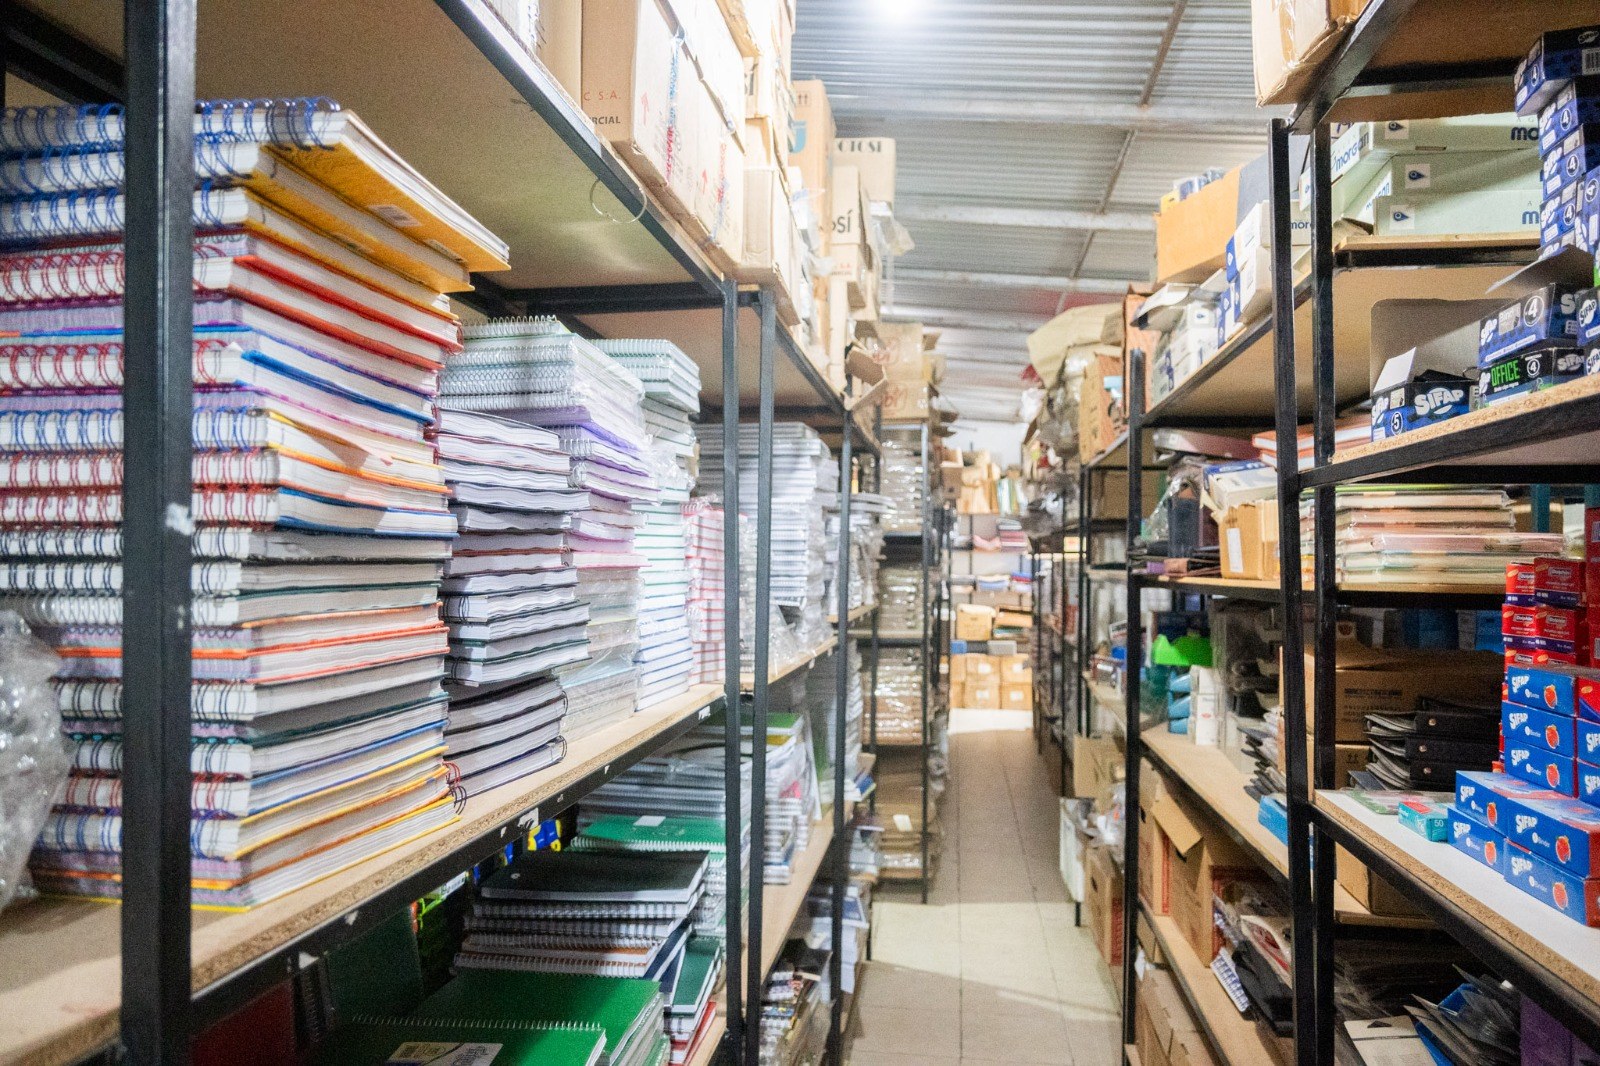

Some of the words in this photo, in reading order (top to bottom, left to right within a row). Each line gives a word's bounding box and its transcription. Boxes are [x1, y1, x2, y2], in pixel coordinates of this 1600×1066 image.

[590, 116, 621, 125] RCIAL
[1511, 126, 1540, 141] mo
[1335, 131, 1370, 172] morgan
[1290, 220, 1312, 230] mor
[1587, 352, 1600, 374] SIFA
[1490, 360, 1520, 387] OFFICE
[1414, 388, 1464, 416] SIFAP
[1511, 675, 1530, 694] SIFAP
[1508, 712, 1529, 730] SIFAP
[1510, 749, 1530, 766] SIFAP
[1434, 819, 1444, 828] 50
[1515, 814, 1538, 834] SIFAP
[1511, 856, 1533, 876] SIFAP
